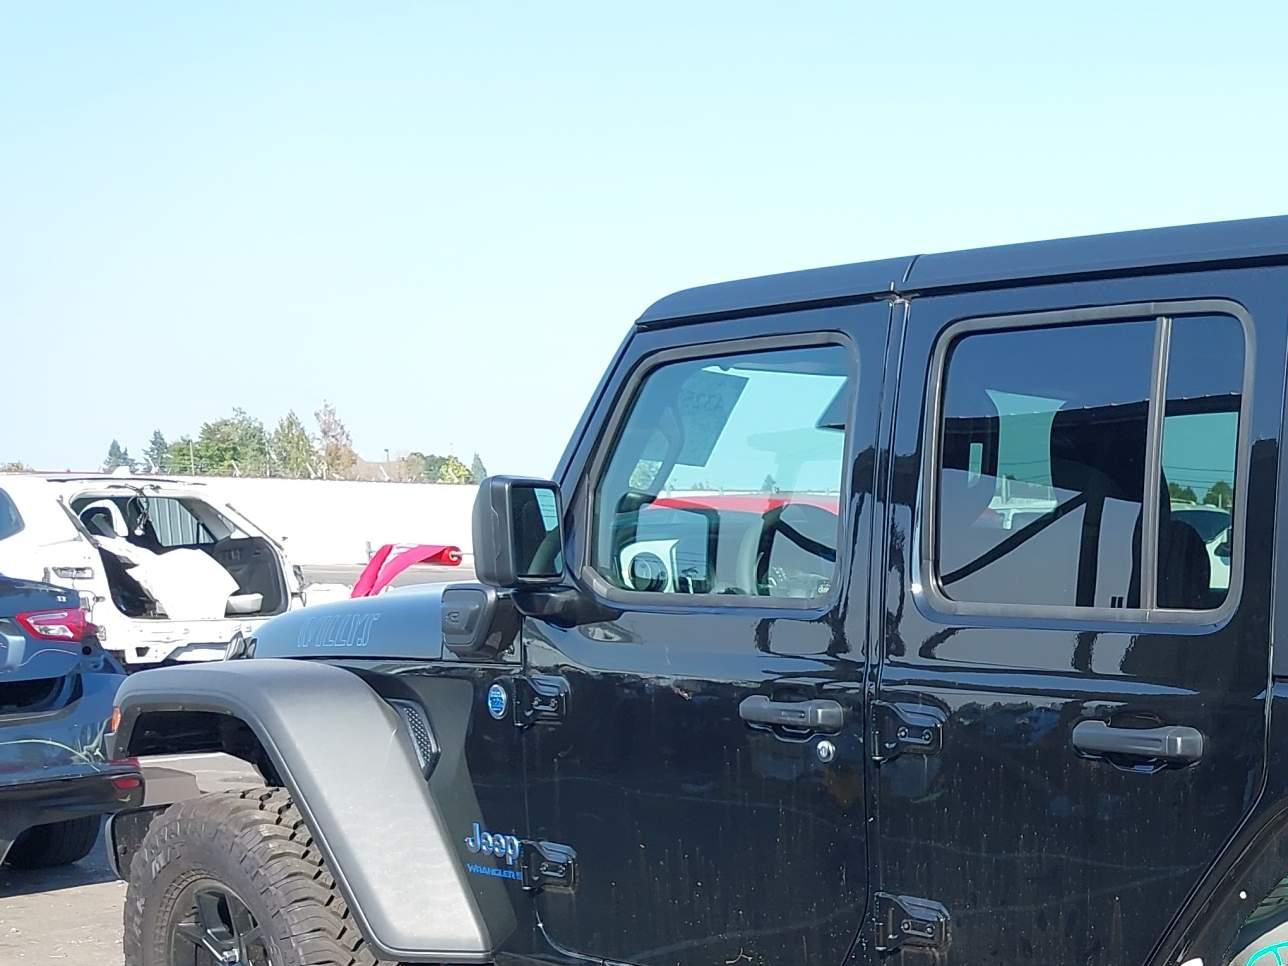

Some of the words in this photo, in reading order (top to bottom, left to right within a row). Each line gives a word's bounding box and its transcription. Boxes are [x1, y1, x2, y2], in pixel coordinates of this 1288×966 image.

[297, 613, 382, 647] WILLYS
[464, 822, 520, 865] Jeep
[466, 863, 516, 880] WRANGLER
